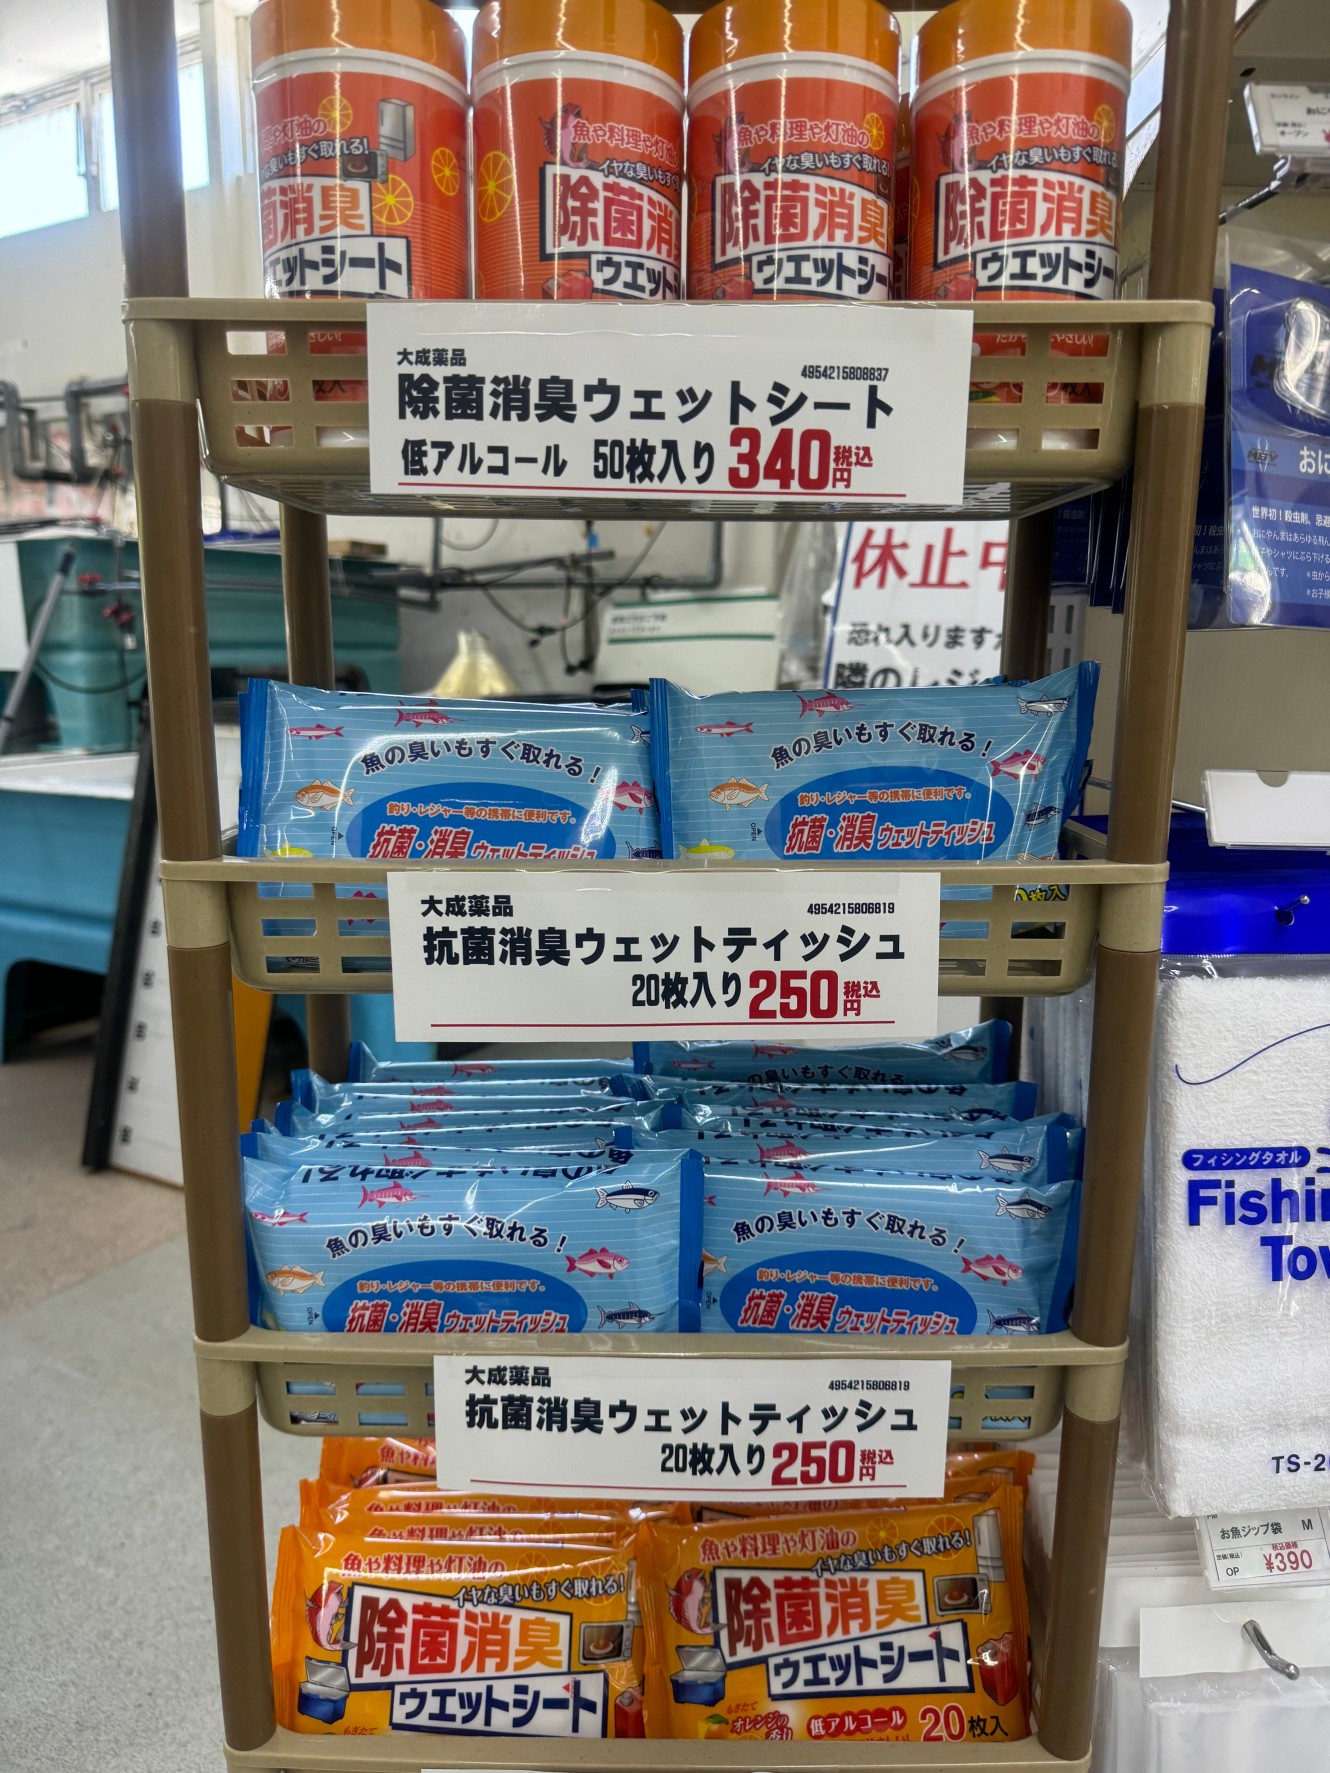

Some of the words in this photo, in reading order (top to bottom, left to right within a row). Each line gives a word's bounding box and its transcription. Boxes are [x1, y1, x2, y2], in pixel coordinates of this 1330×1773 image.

[738, 118, 871, 148] 魚や料理や灯油の
[967, 114, 1099, 145] 魚や料理や灯油の
[262, 137, 369, 179] な臭いもすぐ取れる！
[599, 159, 680, 190] イヤな臭いもすぐ
[552, 173, 680, 261] 除菌消
[721, 177, 888, 257] 除菌消臭
[944, 174, 1114, 256] 除菌消臭
[397, 348, 467, 367] 大成薬品
[801, 364, 889, 382] 4954215808837
[398, 373, 894, 429] 除菌消臭ウェットシート
[401, 438, 568, 477] 低アルコール
[593, 438, 715, 485] 50枚入り
[360, 739, 602, 784] 魚の臭いもすぐ取れる！
[770, 721, 993, 770] 魚の臭いもすぐ取れる！
[420, 895, 514, 918] 大成薬品
[807, 902, 895, 915] 4954215806819
[423, 925, 905, 966] 抗菌消臭ウェットティッシュ
[631, 971, 742, 1009] 20枚入り
[1188, 1177, 1330, 1226] Fishi
[324, 1213, 567, 1260] 魚の臭いもすぐ取れる！
[732, 1207, 966, 1254] 魚の臭いもすぐ取れる！
[464, 1366, 552, 1387] 大成薬品
[828, 1379, 910, 1391] 4954215806819
[465, 1393, 918, 1435] 抗菌消臭ウェットティッシュ
[660, 1442, 765, 1476] 20枚入り
[1271, 1454, 1330, 1474] TS-2
[1301, 1519, 1313, 1530] M
[700, 1528, 857, 1563] 魚や料理や灯油の
[811, 1529, 972, 1578] イヤな臭いもすぐ取れる！
[1263, 1549, 1312, 1573] ¥390
[1225, 1566, 1240, 1577] OP
[454, 1575, 625, 1608] イヤな臭いもすぐ取れる！
[723, 1573, 923, 1657] 除菌消臭
[354, 1594, 563, 1679] 除菌消臭
[731, 1710, 789, 1734] オレンジの
[810, 1711, 905, 1736] 低アルコール
